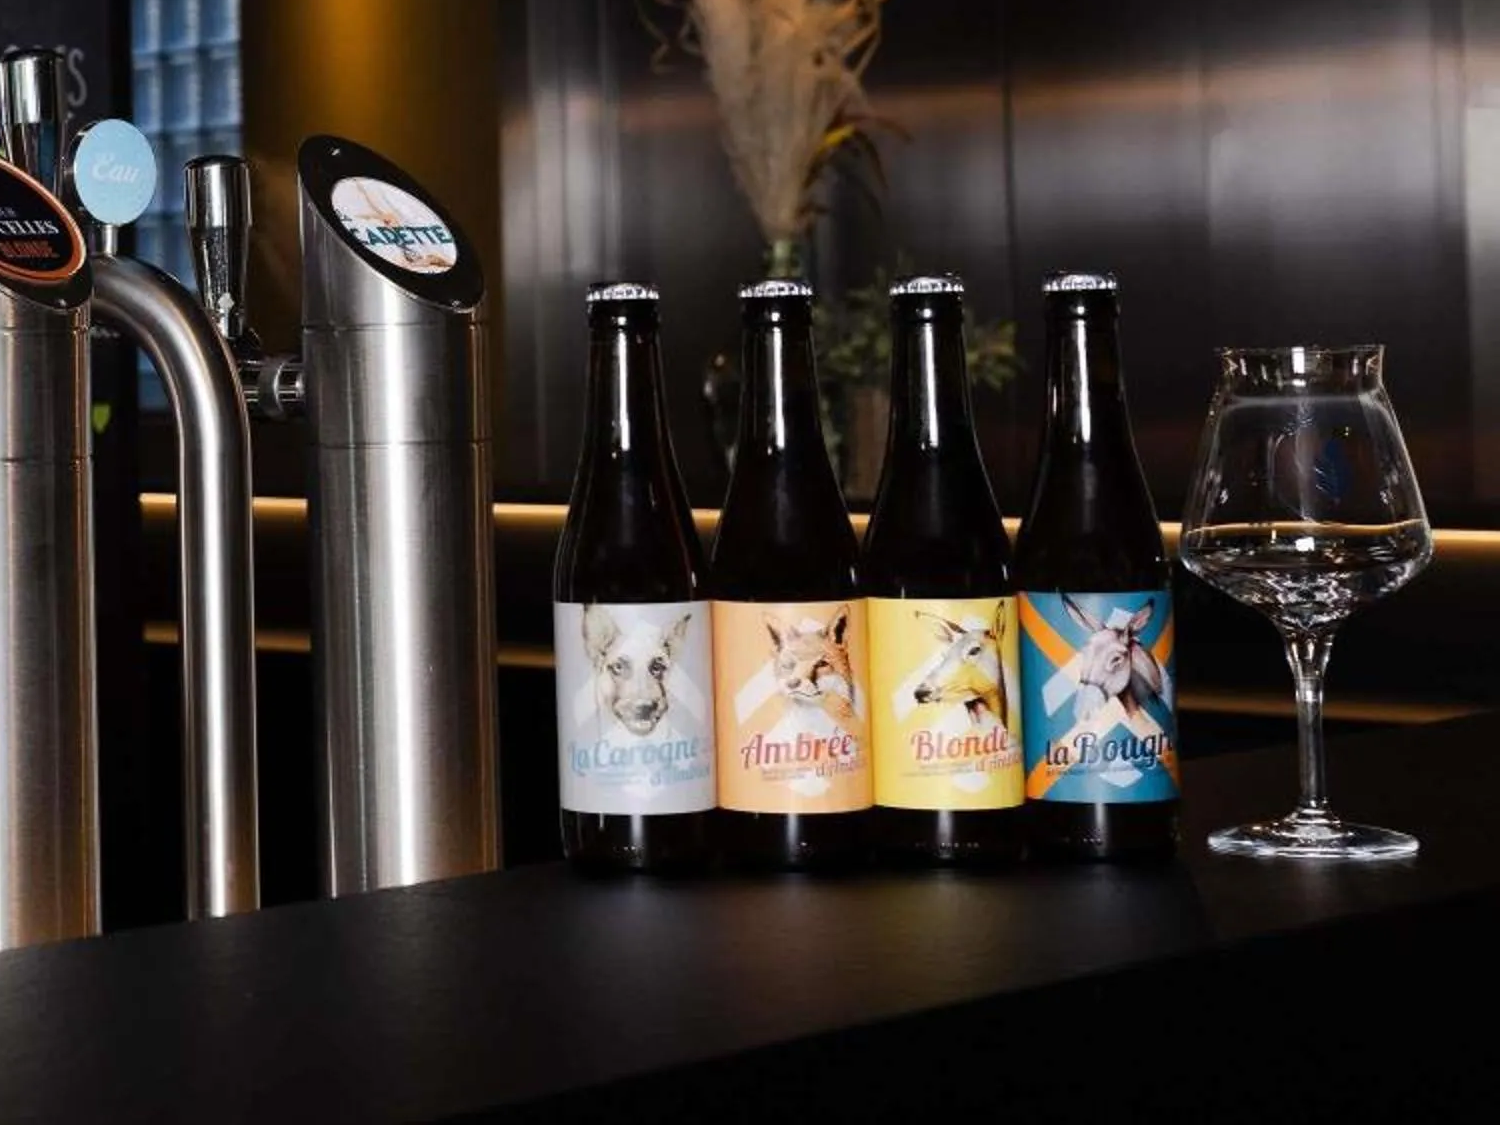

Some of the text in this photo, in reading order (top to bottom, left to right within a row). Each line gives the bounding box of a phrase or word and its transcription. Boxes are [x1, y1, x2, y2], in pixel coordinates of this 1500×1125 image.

[91, 152, 139, 183] Eau
[741, 726, 853, 770] Ambrée
[911, 725, 1008, 761] Blonde
[1046, 739, 1069, 765] la
